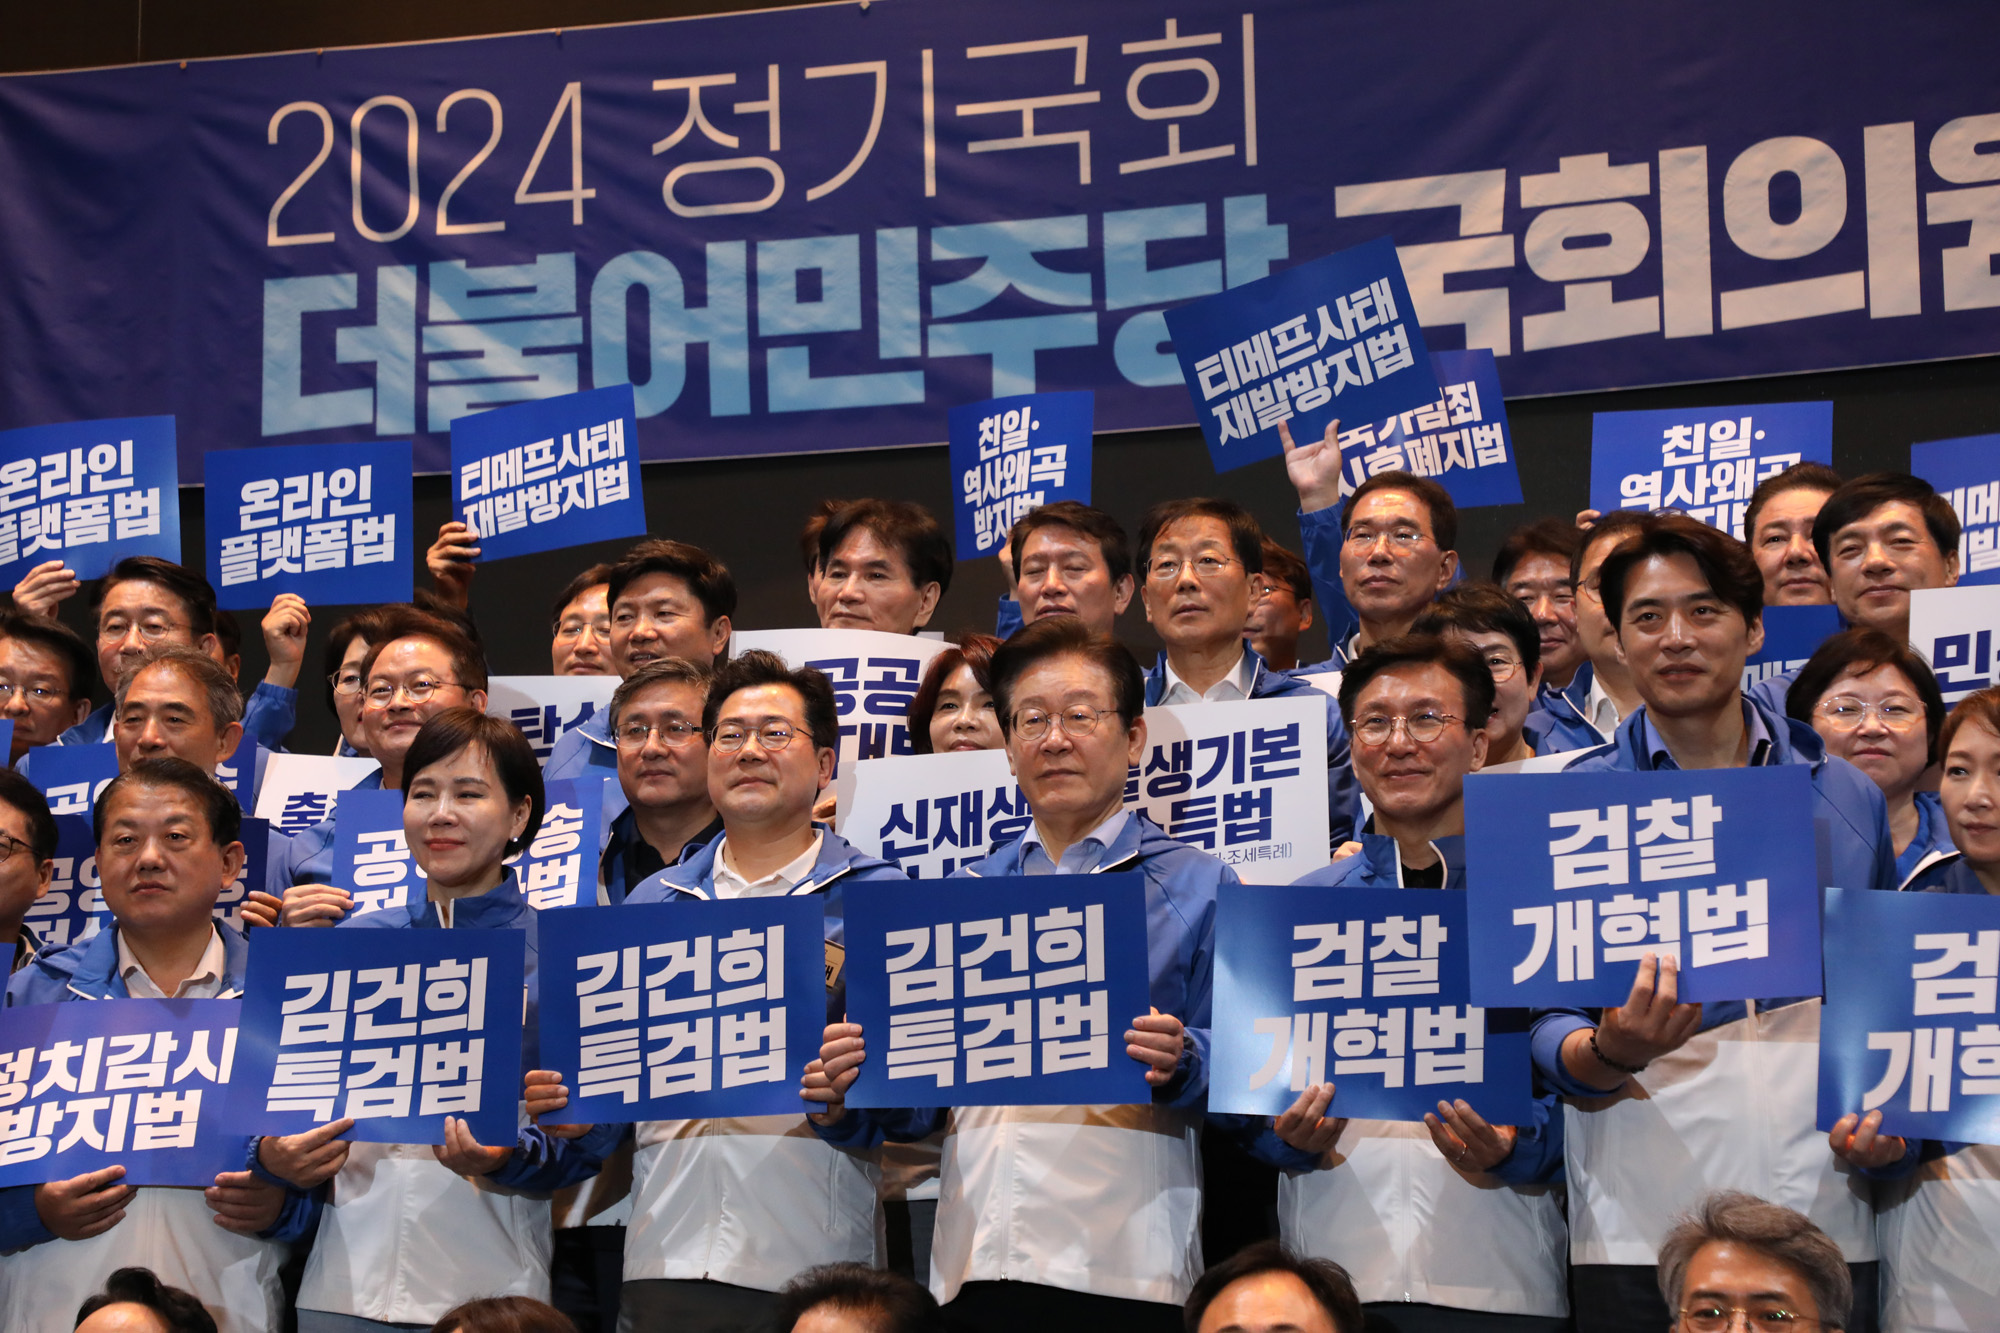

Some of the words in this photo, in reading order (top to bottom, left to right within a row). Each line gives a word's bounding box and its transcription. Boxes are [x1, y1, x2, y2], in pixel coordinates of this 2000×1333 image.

[267, 81, 596, 246] 2024
[652, 13, 1257, 218] 정기국회
[261, 194, 1289, 436] 더불어민주당
[1195, 277, 1399, 401] 티메프사태
[1212, 323, 1414, 447] 재발방지법
[0, 440, 134, 513] 온라인
[239, 464, 372, 531] 온라인
[461, 418, 625, 501] 티메프사태
[463, 460, 630, 539] 재발방지법
[963, 444, 1067, 508] 역사왜곡
[220, 513, 395, 587] 플랫폼법
[1136, 787, 1272, 850] 득법
[1549, 794, 1723, 891] 검찰
[886, 903, 1106, 1007] 김건희
[1292, 915, 1448, 1002] 검찰
[1513, 878, 1770, 985] 개혁법
[281, 957, 488, 1046] 김건희
[576, 924, 785, 1028] 김건희
[266, 1039, 485, 1121] 특검법
[577, 1007, 787, 1104] 특검법
[887, 990, 1109, 1088] 특검법
[1249, 1004, 1485, 1092] 개혁법
[0, 1089, 202, 1167] 방지법
